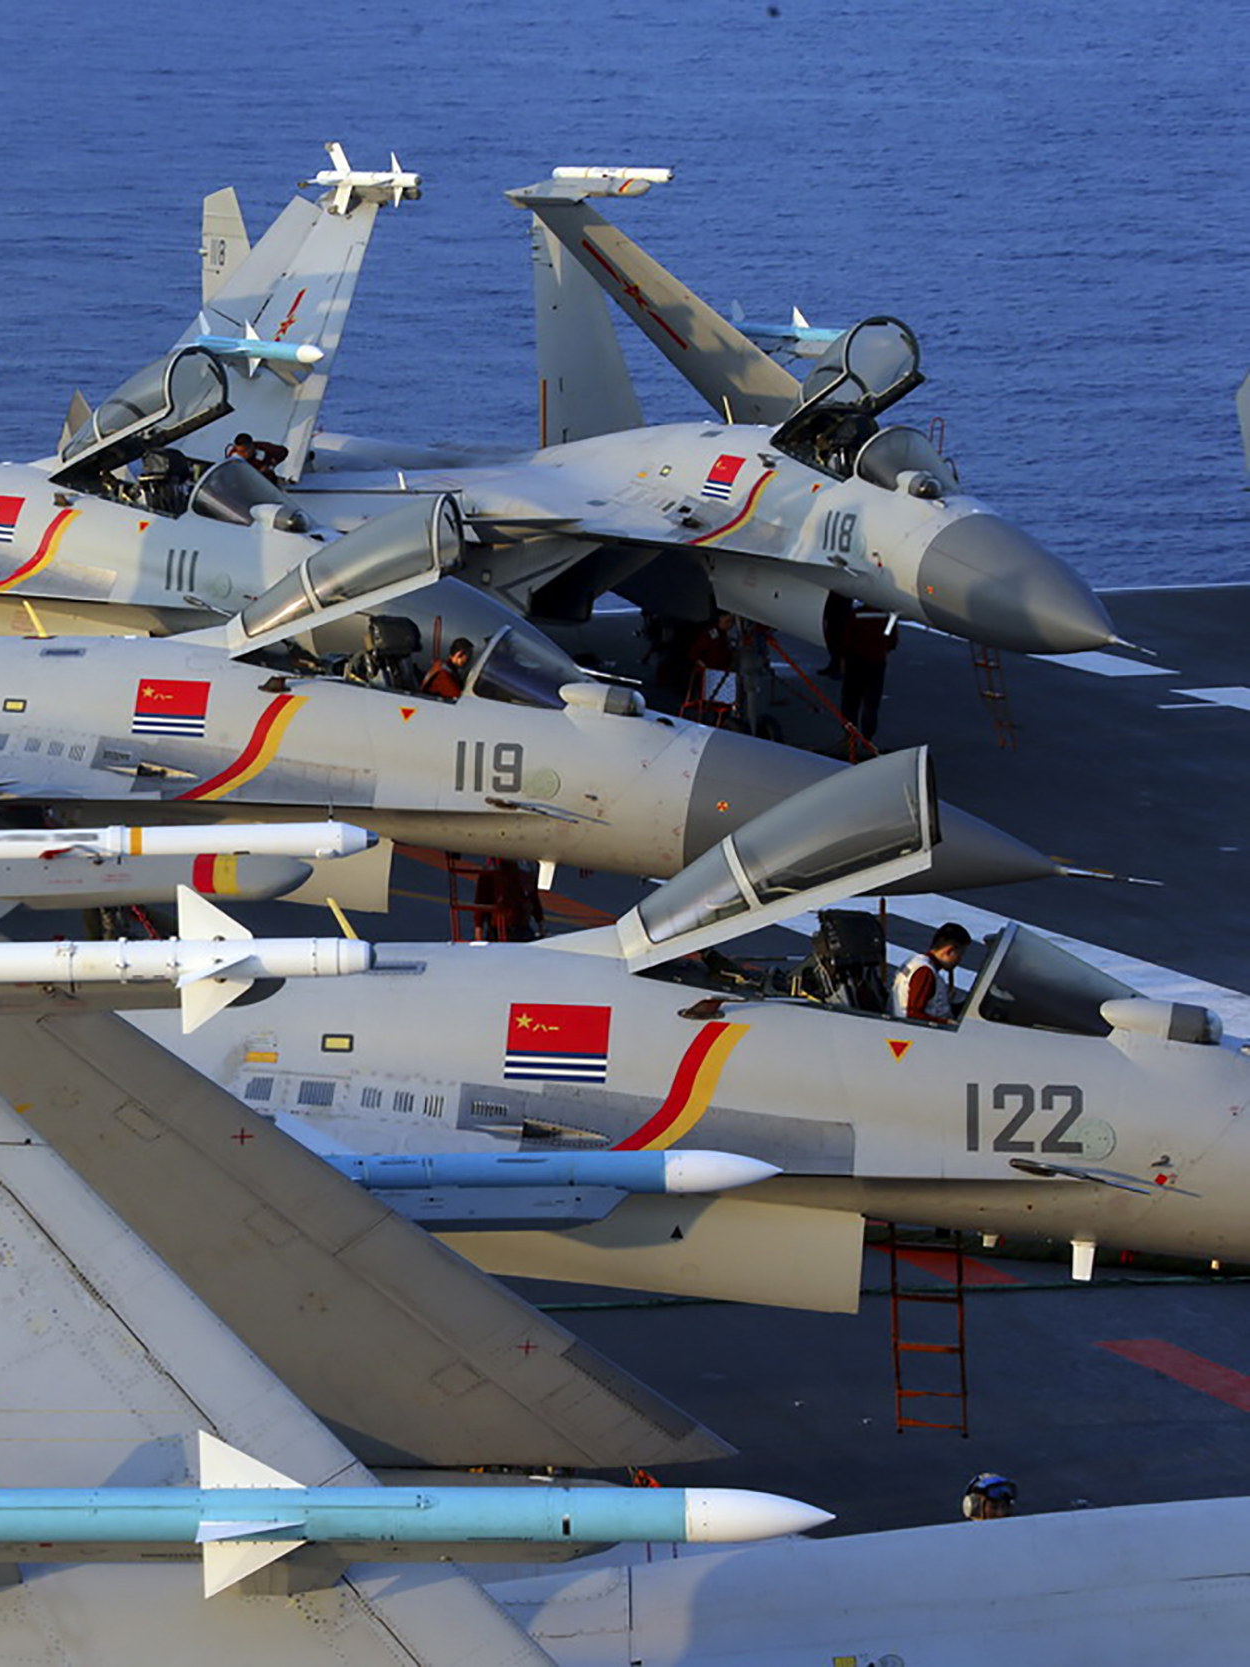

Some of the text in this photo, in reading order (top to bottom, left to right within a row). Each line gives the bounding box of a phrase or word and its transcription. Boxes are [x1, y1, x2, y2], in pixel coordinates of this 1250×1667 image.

[822, 509, 857, 553] 118
[165, 549, 198, 592] 111
[455, 740, 524, 793] 119
[966, 1083, 1083, 1153] 122
